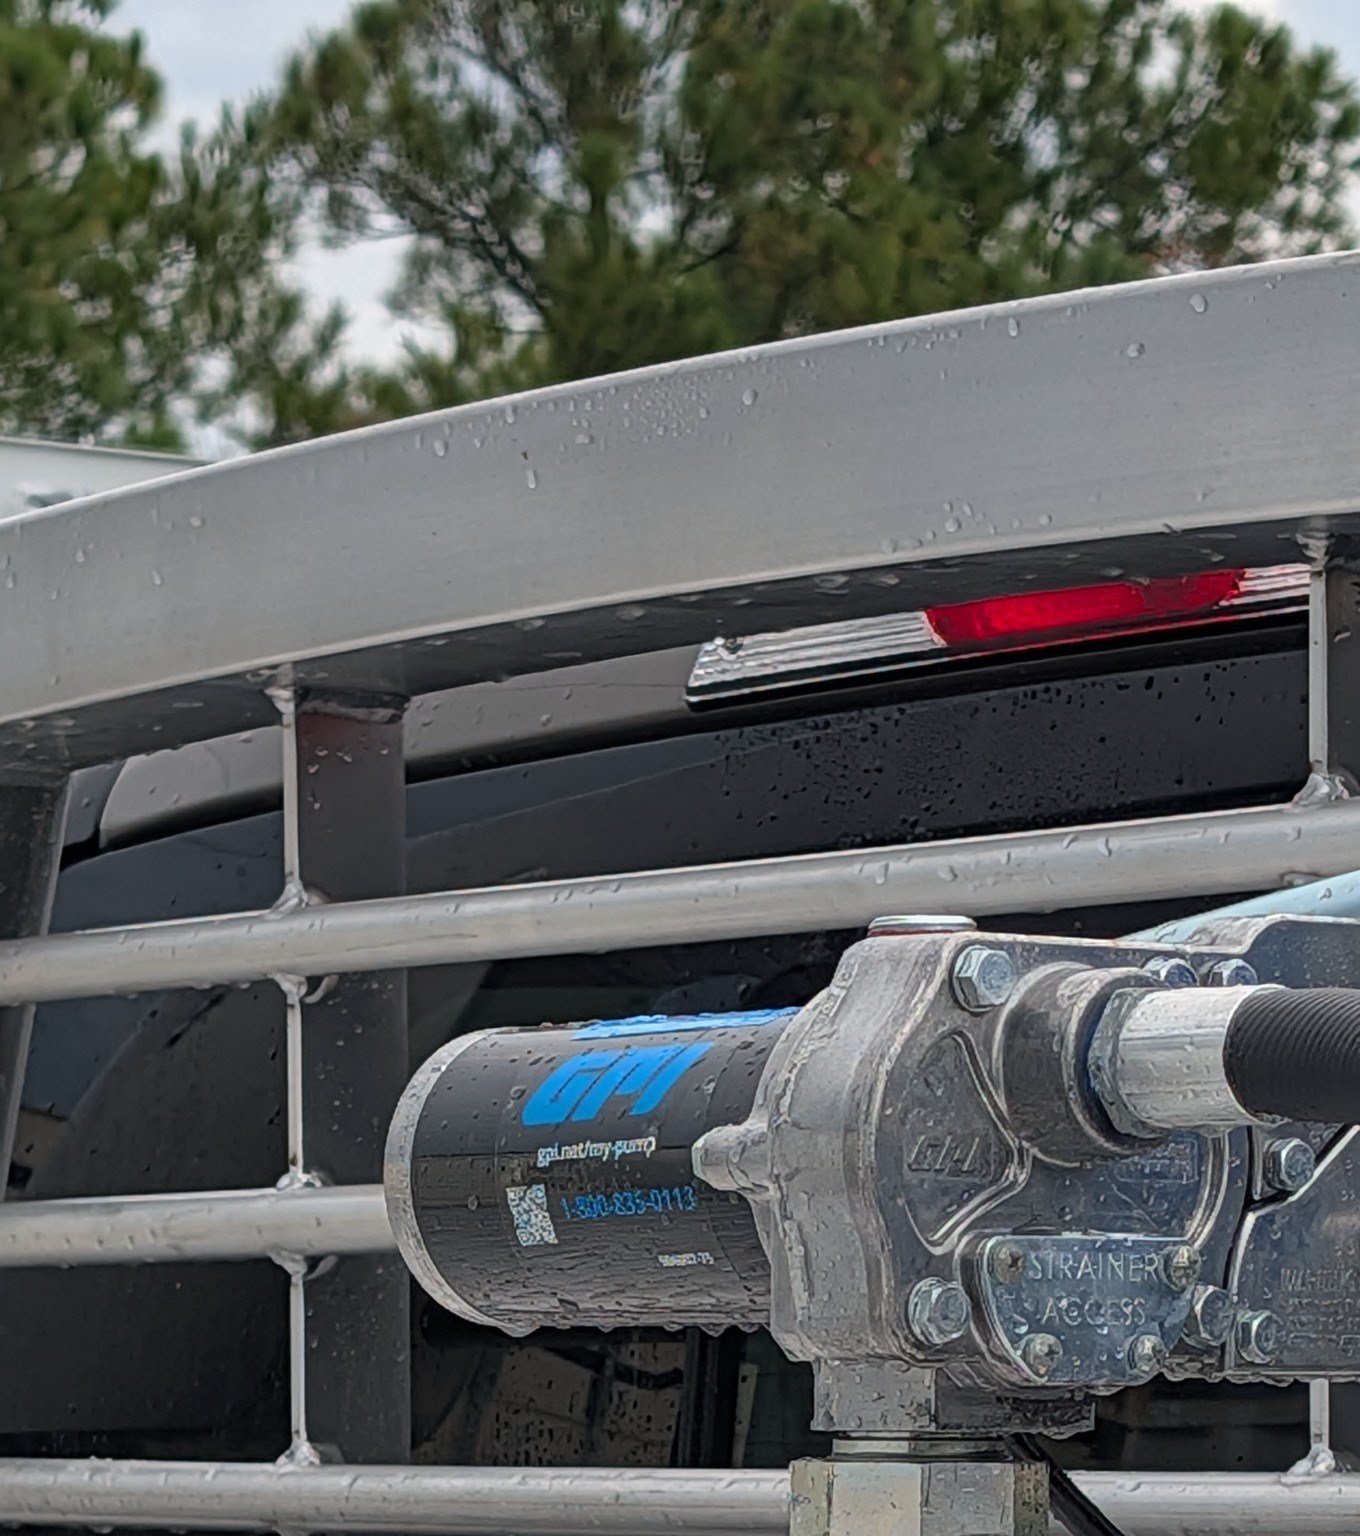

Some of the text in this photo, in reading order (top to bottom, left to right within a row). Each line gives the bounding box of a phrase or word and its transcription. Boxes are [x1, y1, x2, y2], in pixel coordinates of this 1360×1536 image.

[521, 1041, 714, 1127] GPI
[1027, 1252, 1160, 1282] STRAINER
[1039, 1296, 1147, 1327] ACCESS
